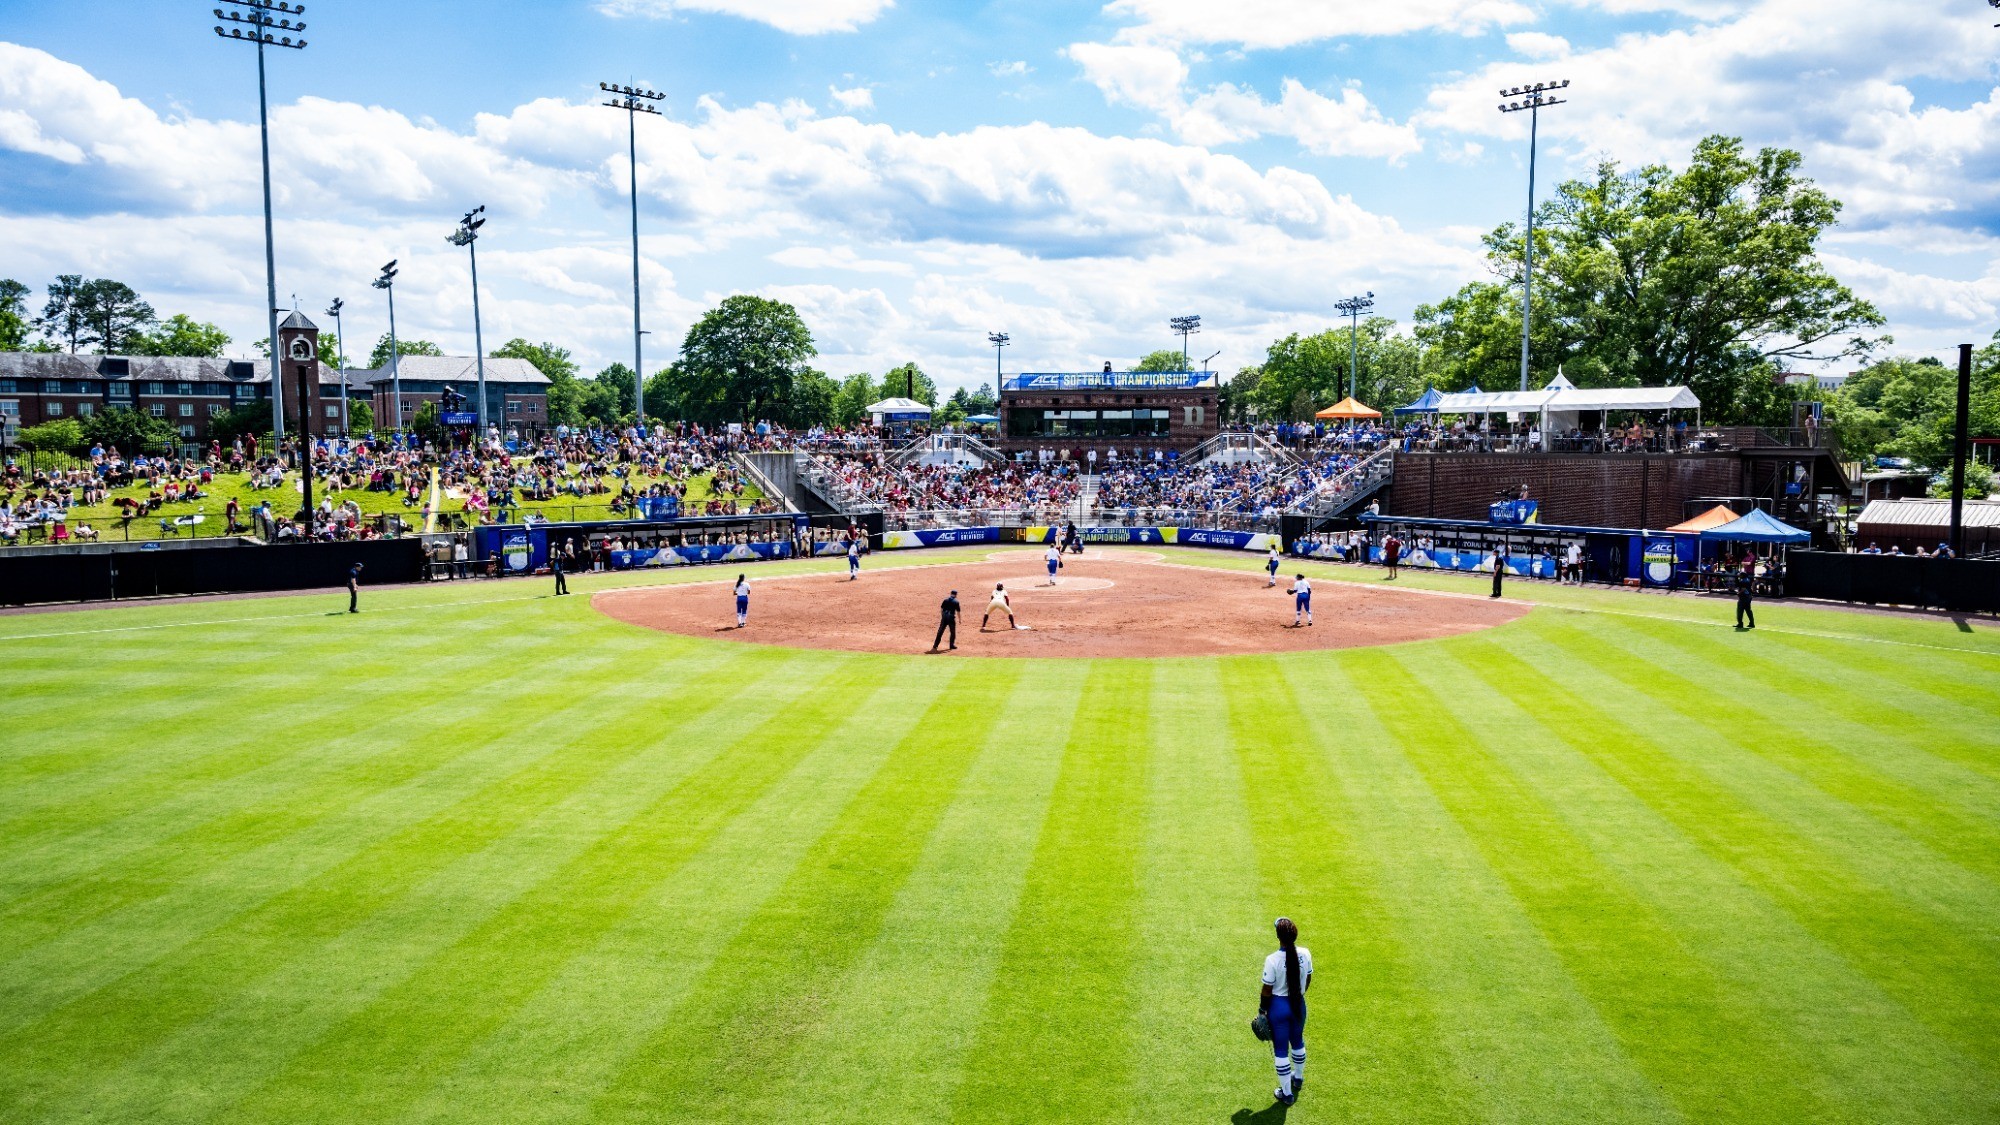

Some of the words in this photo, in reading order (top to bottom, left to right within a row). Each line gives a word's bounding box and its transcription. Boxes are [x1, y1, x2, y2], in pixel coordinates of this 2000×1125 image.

[1028, 375, 1060, 388] ACC
[1063, 373, 1112, 386] SOFTBALL
[1114, 373, 1190, 386] CHAMPIONSHIP
[935, 531, 957, 542] ACC
[1188, 532, 1208, 542] ACC
